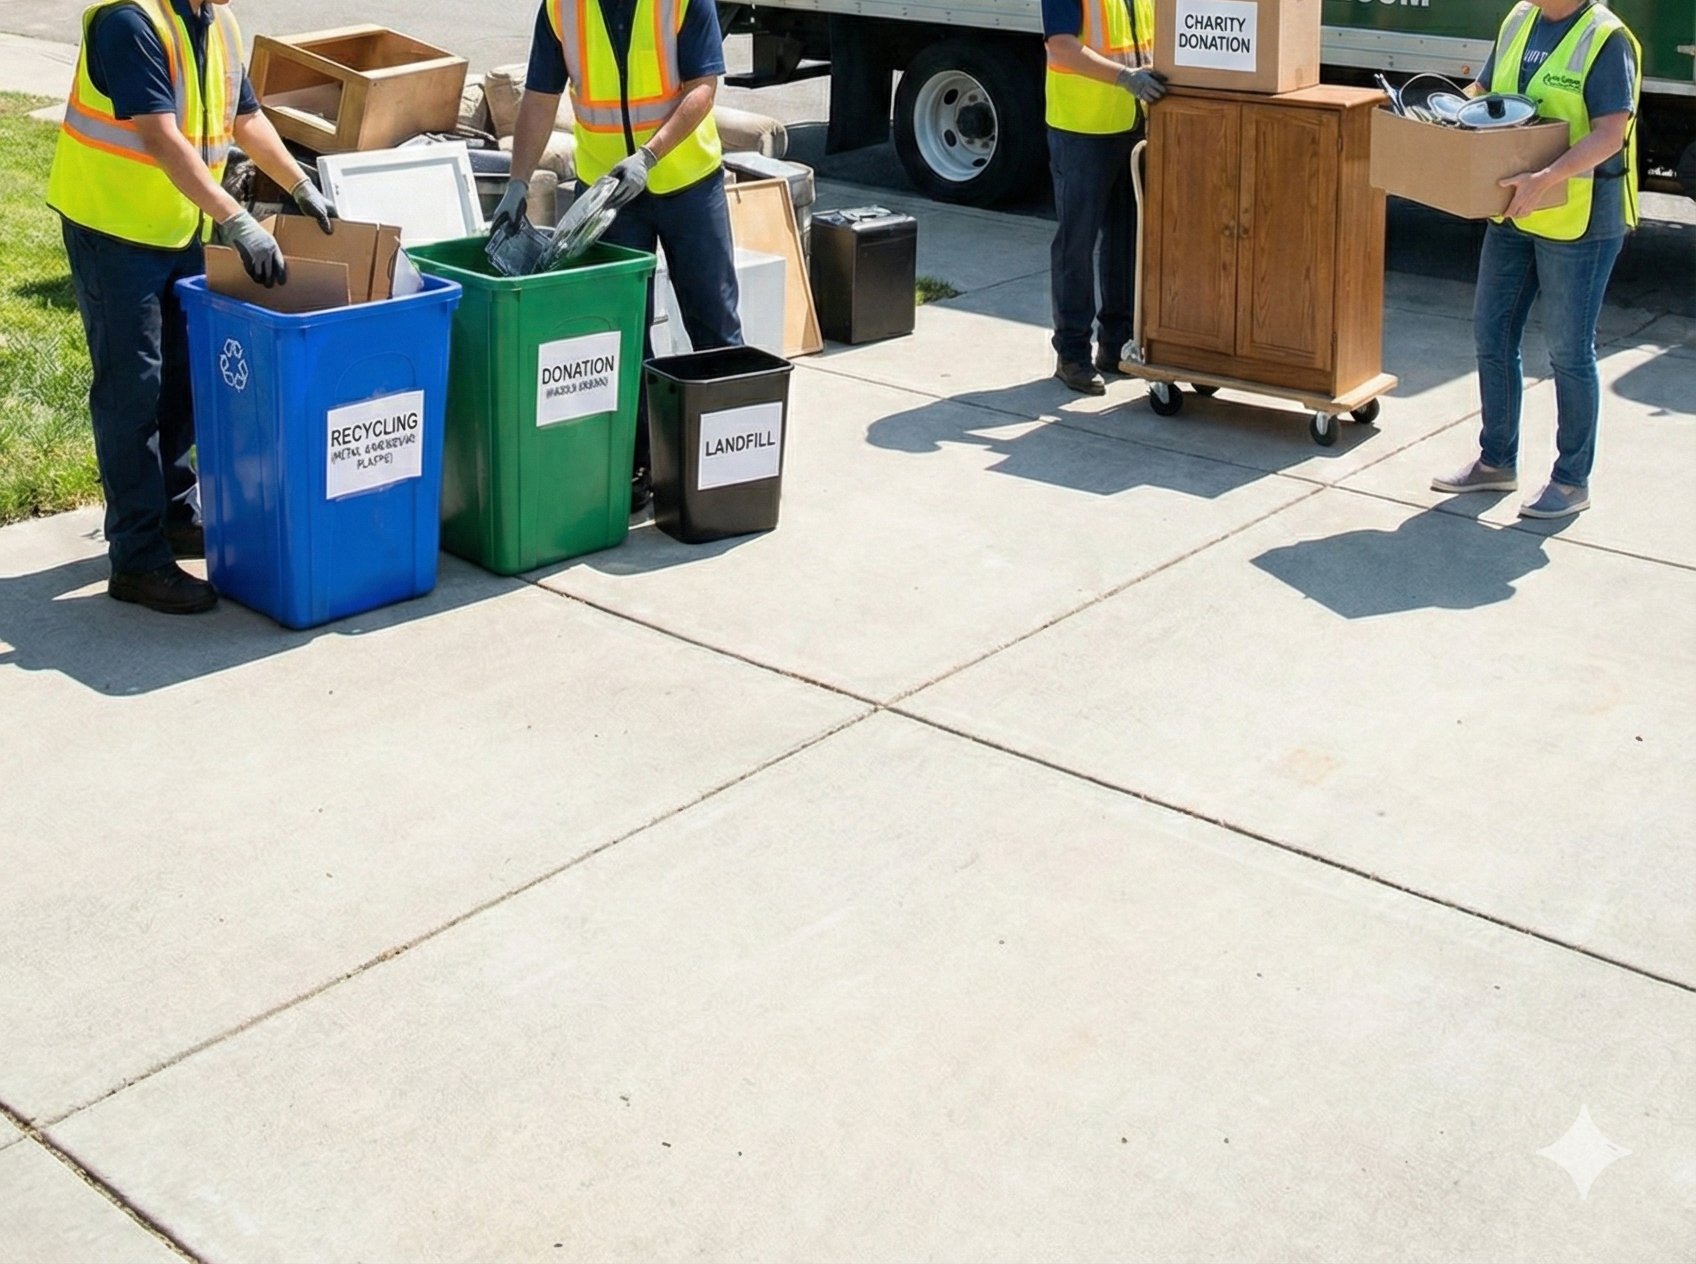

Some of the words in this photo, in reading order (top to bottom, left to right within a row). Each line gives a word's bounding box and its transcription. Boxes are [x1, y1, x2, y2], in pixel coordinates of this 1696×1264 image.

[1184, 13, 1247, 33] CHARITY
[1179, 32, 1251, 54] DONATION
[542, 354, 615, 385] DONATION
[331, 412, 418, 447] RECYCLING
[705, 430, 776, 457] LANDFILL
